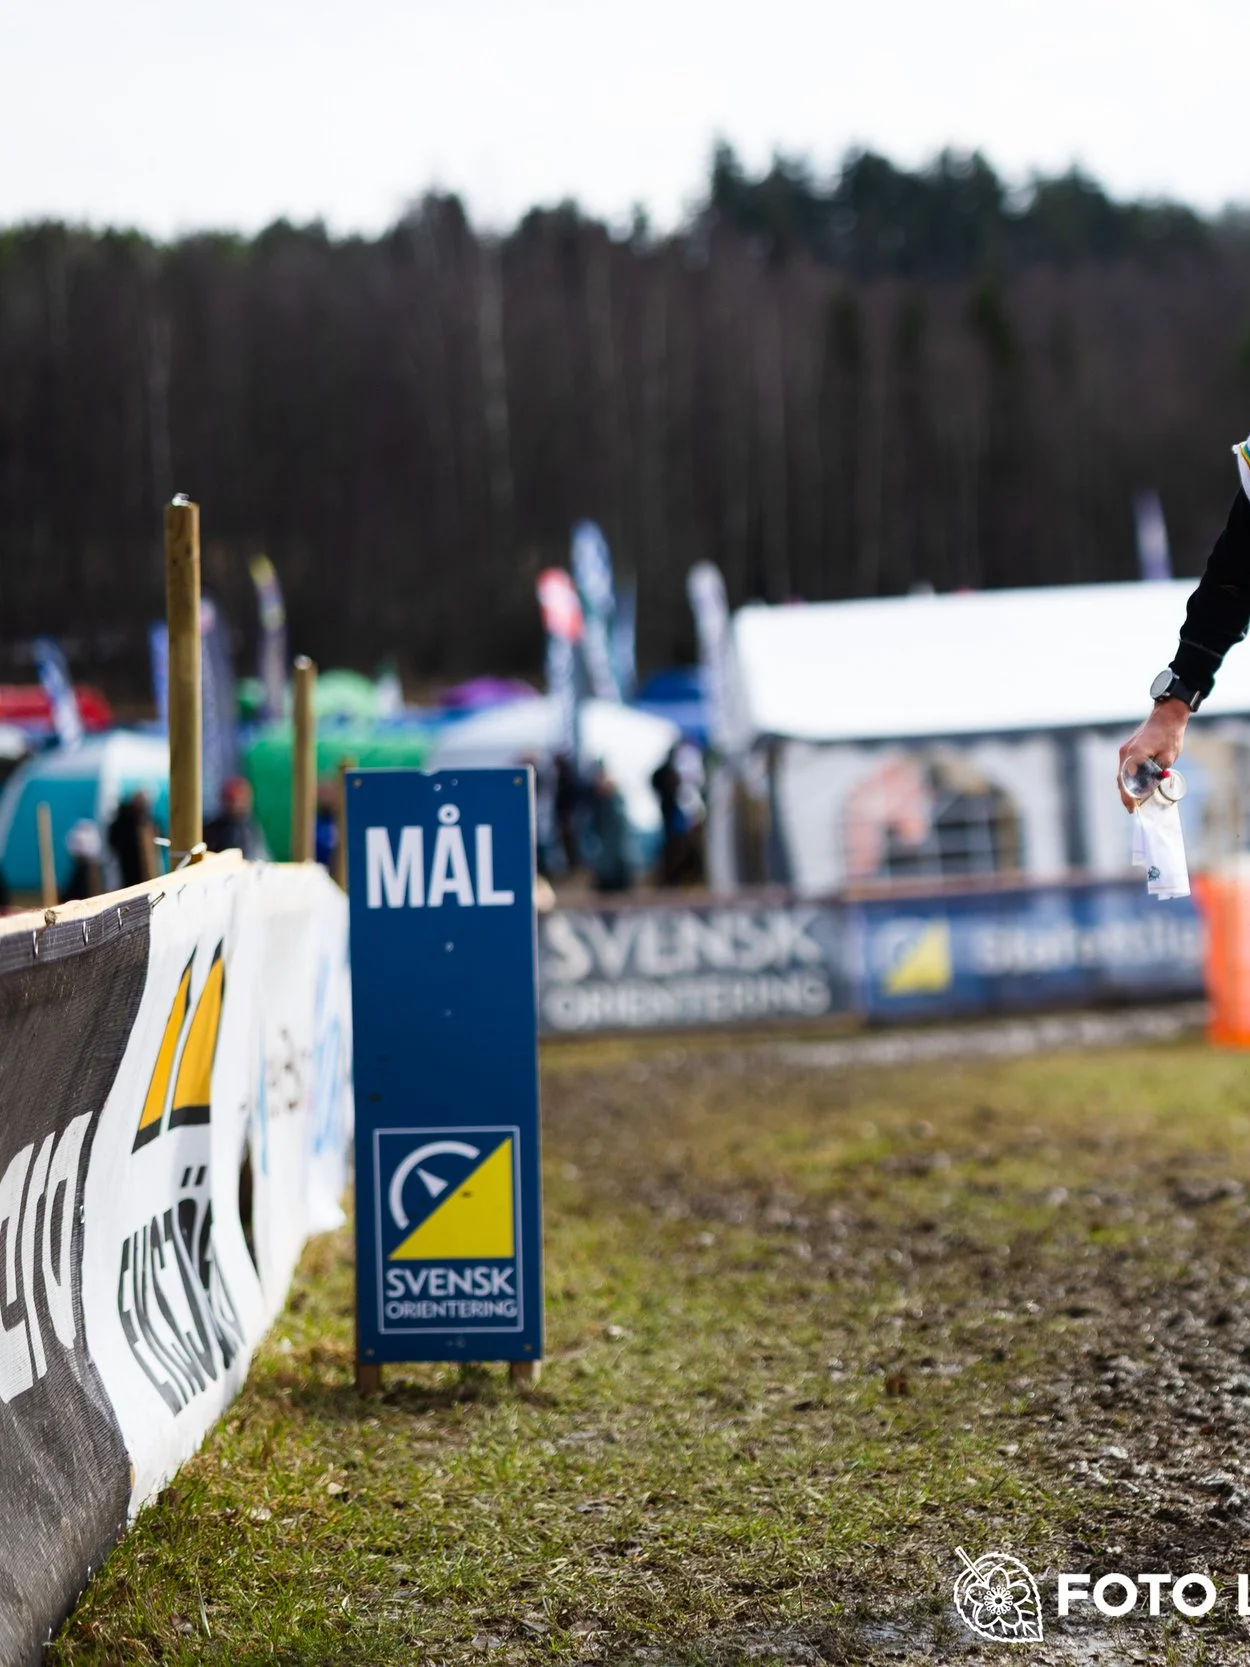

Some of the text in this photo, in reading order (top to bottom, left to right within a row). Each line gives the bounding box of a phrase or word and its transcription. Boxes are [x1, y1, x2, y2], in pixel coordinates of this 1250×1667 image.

[365, 803, 515, 909] MÅL
[544, 906, 824, 981] SVENSK
[385, 1266, 516, 1298] SVENSK
[384, 1299, 519, 1320] ORIENTERING
